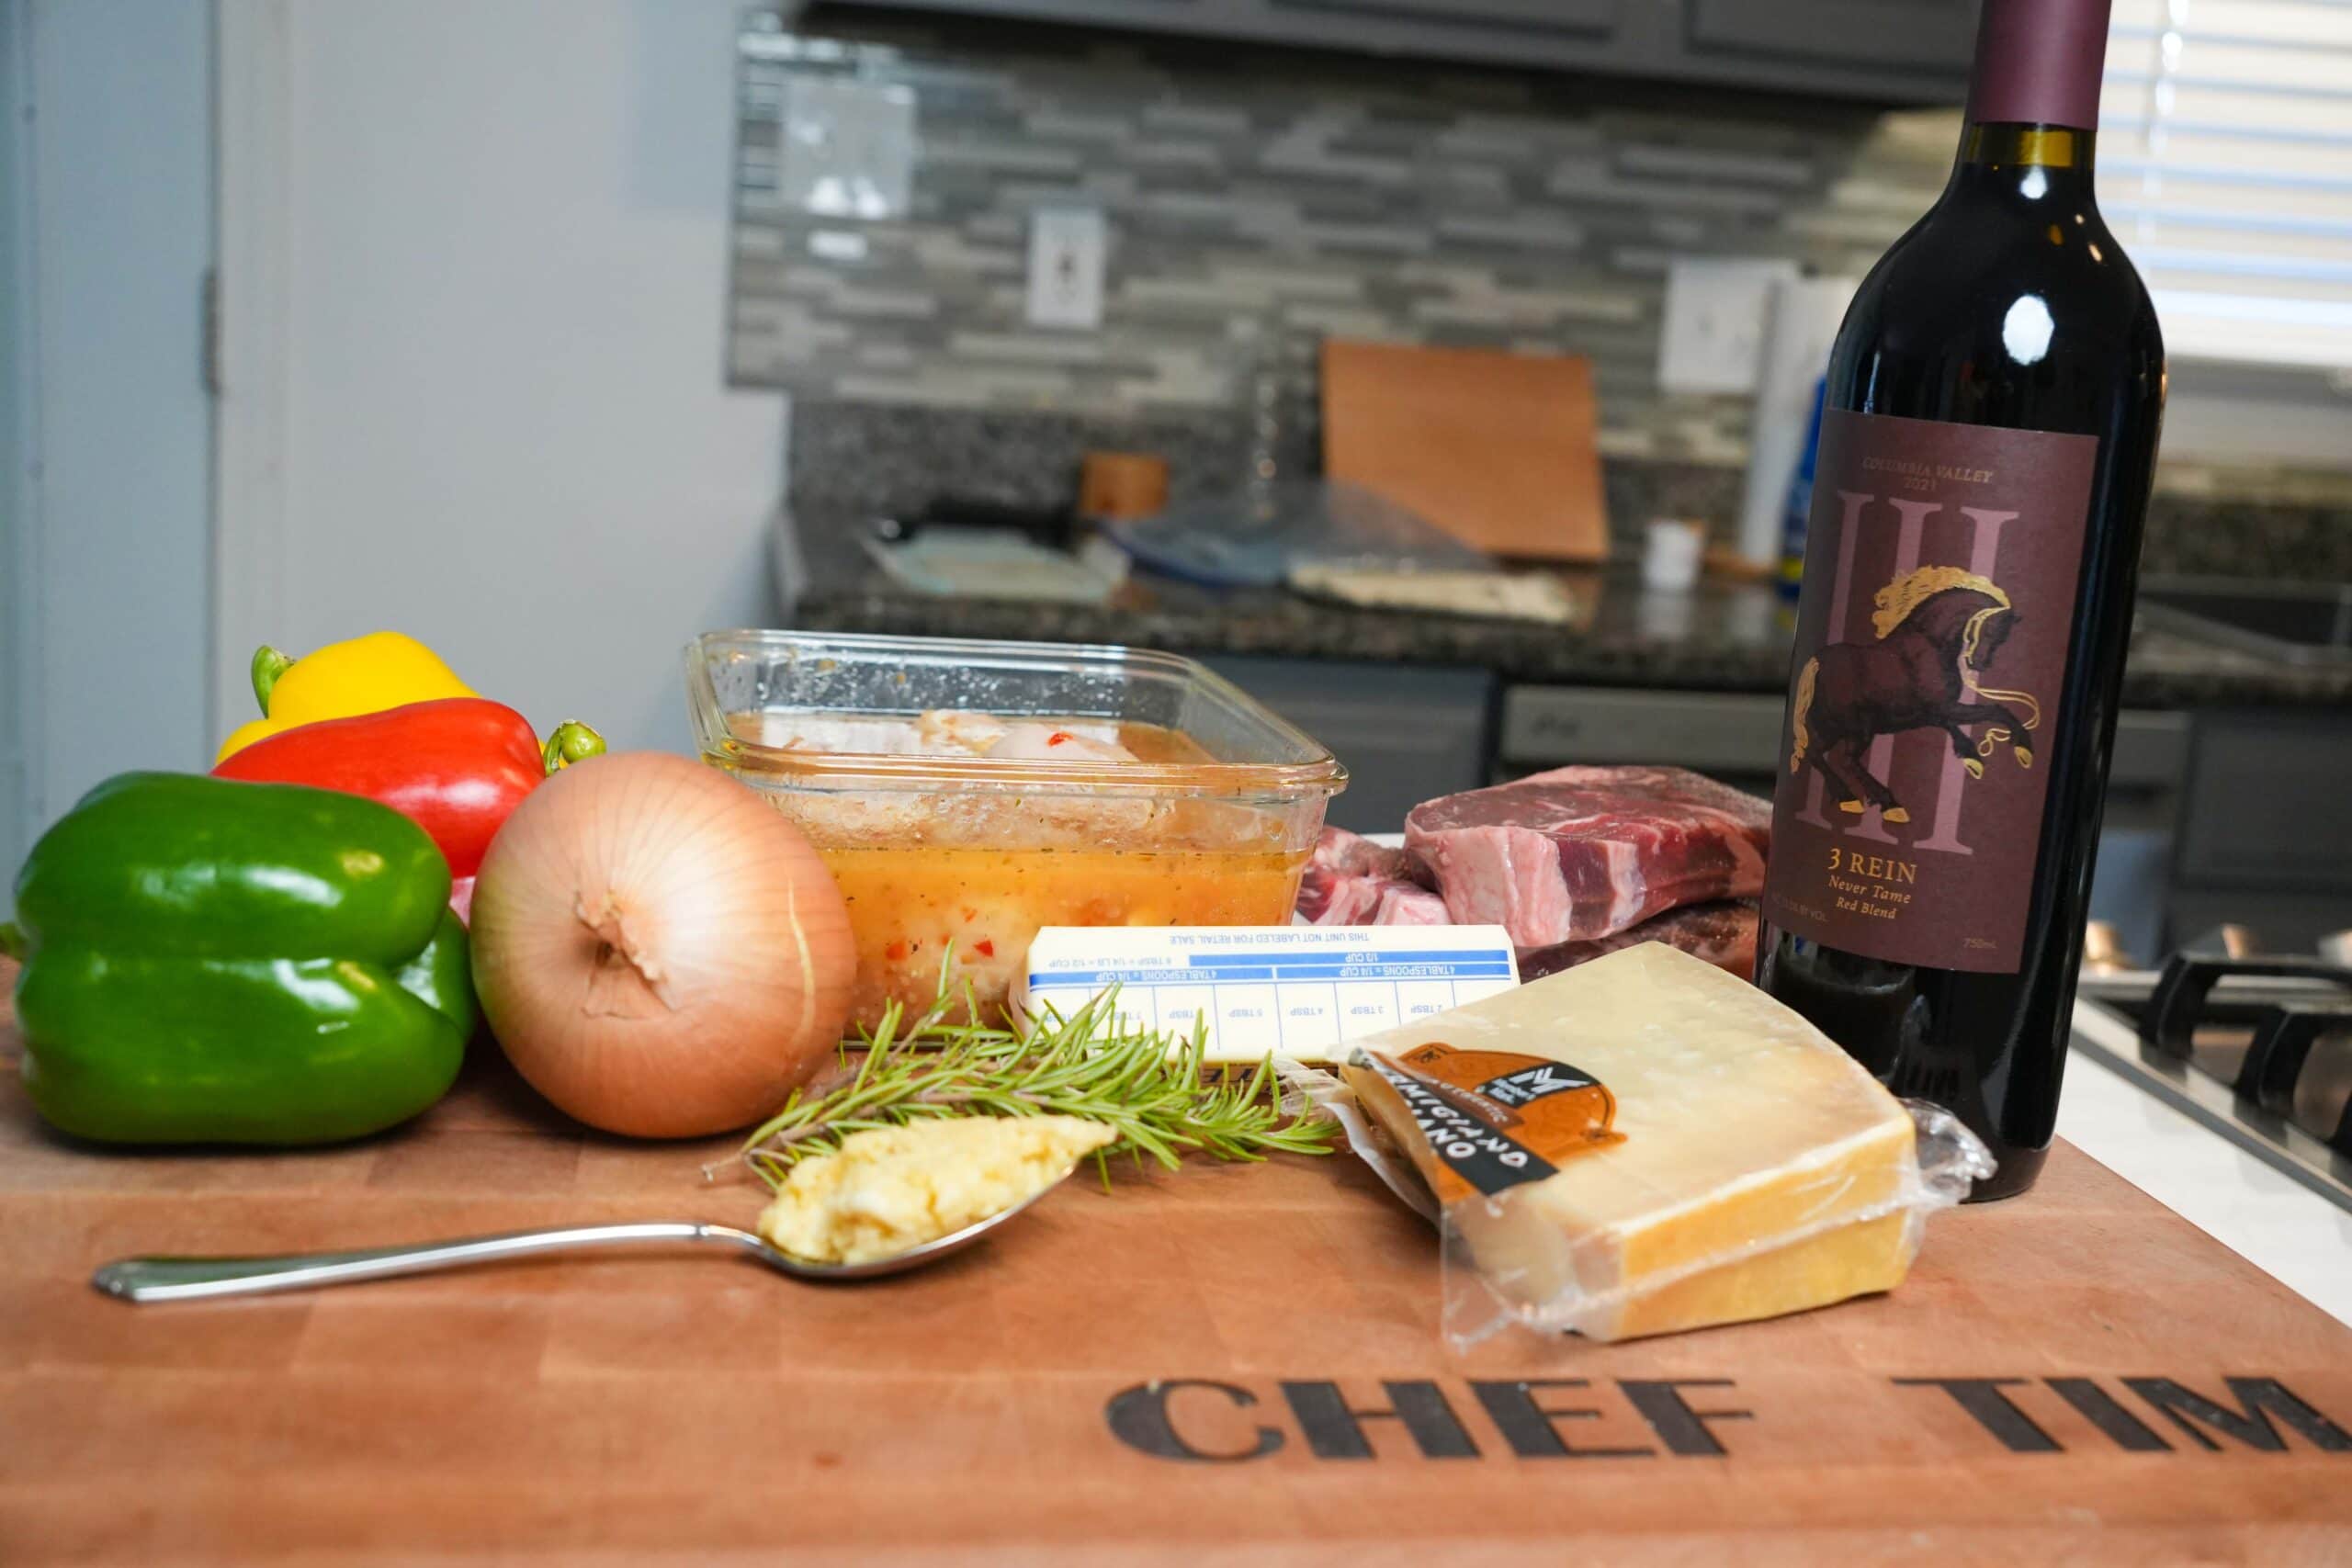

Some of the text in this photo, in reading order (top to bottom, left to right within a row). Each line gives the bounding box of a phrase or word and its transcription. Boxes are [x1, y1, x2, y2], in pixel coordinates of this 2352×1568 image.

[1936, 465, 1993, 484] VALLEY
[1827, 848, 1917, 884] 3 REIN
[1828, 874, 1911, 904] Never Tame
[1836, 896, 1897, 919] Red Blend
[1169, 932, 1370, 946] THIS UNIT NOT LABELED FOR RETAIL SALE
[1048, 958, 1071, 969] CUP
[1344, 952, 1379, 964] 1/3 CUP
[1141, 970, 1210, 982] TABLESPOONS
[1210, 970, 1217, 980] 4
[1340, 966, 1360, 977] CUP
[1360, 966, 1374, 976] 1/4
[1383, 965, 1451, 976] TABLESPOONS
[1095, 971, 1115, 983] CUP
[1169, 1010, 1194, 1020] TBSP
[1228, 1009, 1256, 1018] TBSP
[1290, 1007, 1316, 1016] TBSP
[1350, 1006, 1376, 1015] TBSP
[1410, 1005, 1435, 1014] TBSP
[1104, 1376, 2352, 1462] CHEF TIM
